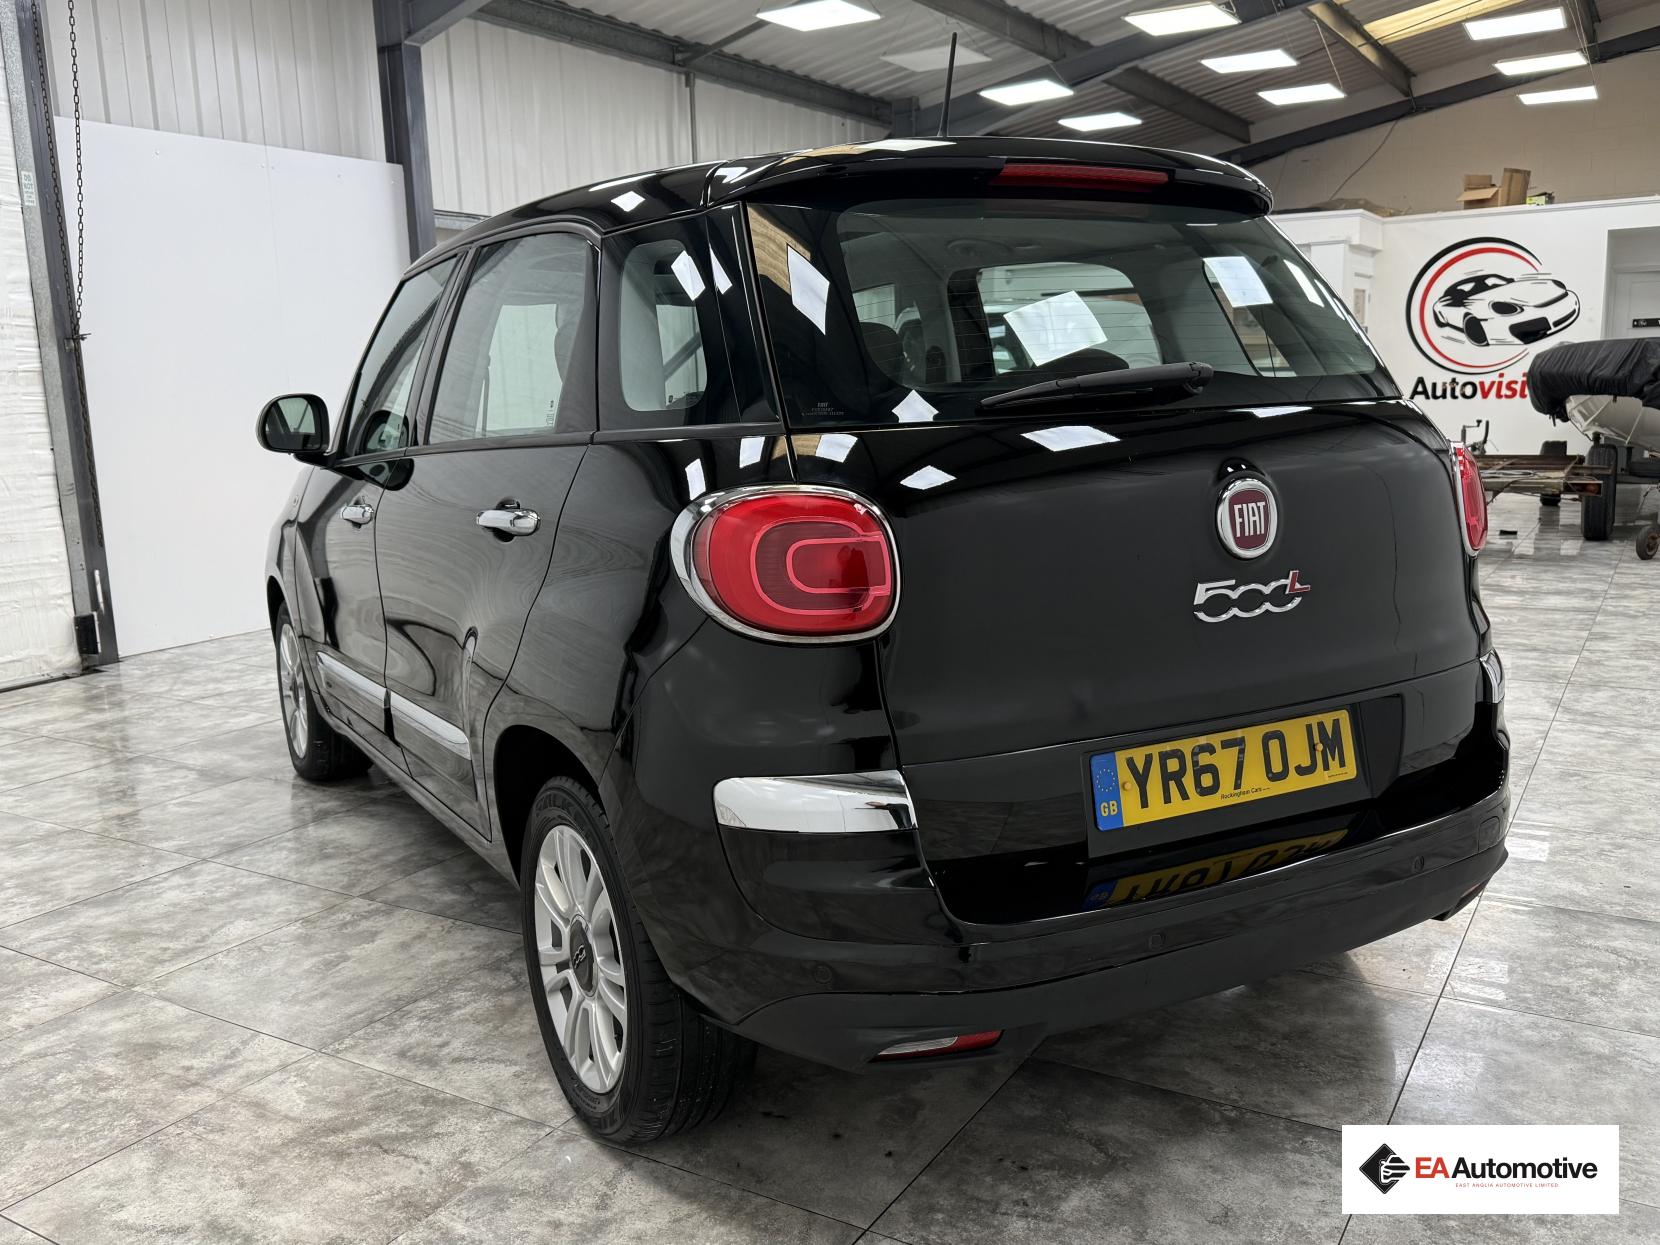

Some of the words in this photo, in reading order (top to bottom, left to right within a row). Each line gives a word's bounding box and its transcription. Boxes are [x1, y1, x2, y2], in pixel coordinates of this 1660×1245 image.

[1233, 501, 1266, 538] FIAT
[1125, 735, 1246, 809] YR67
[1260, 718, 1346, 783] OJM
[1100, 800, 1118, 817] GB
